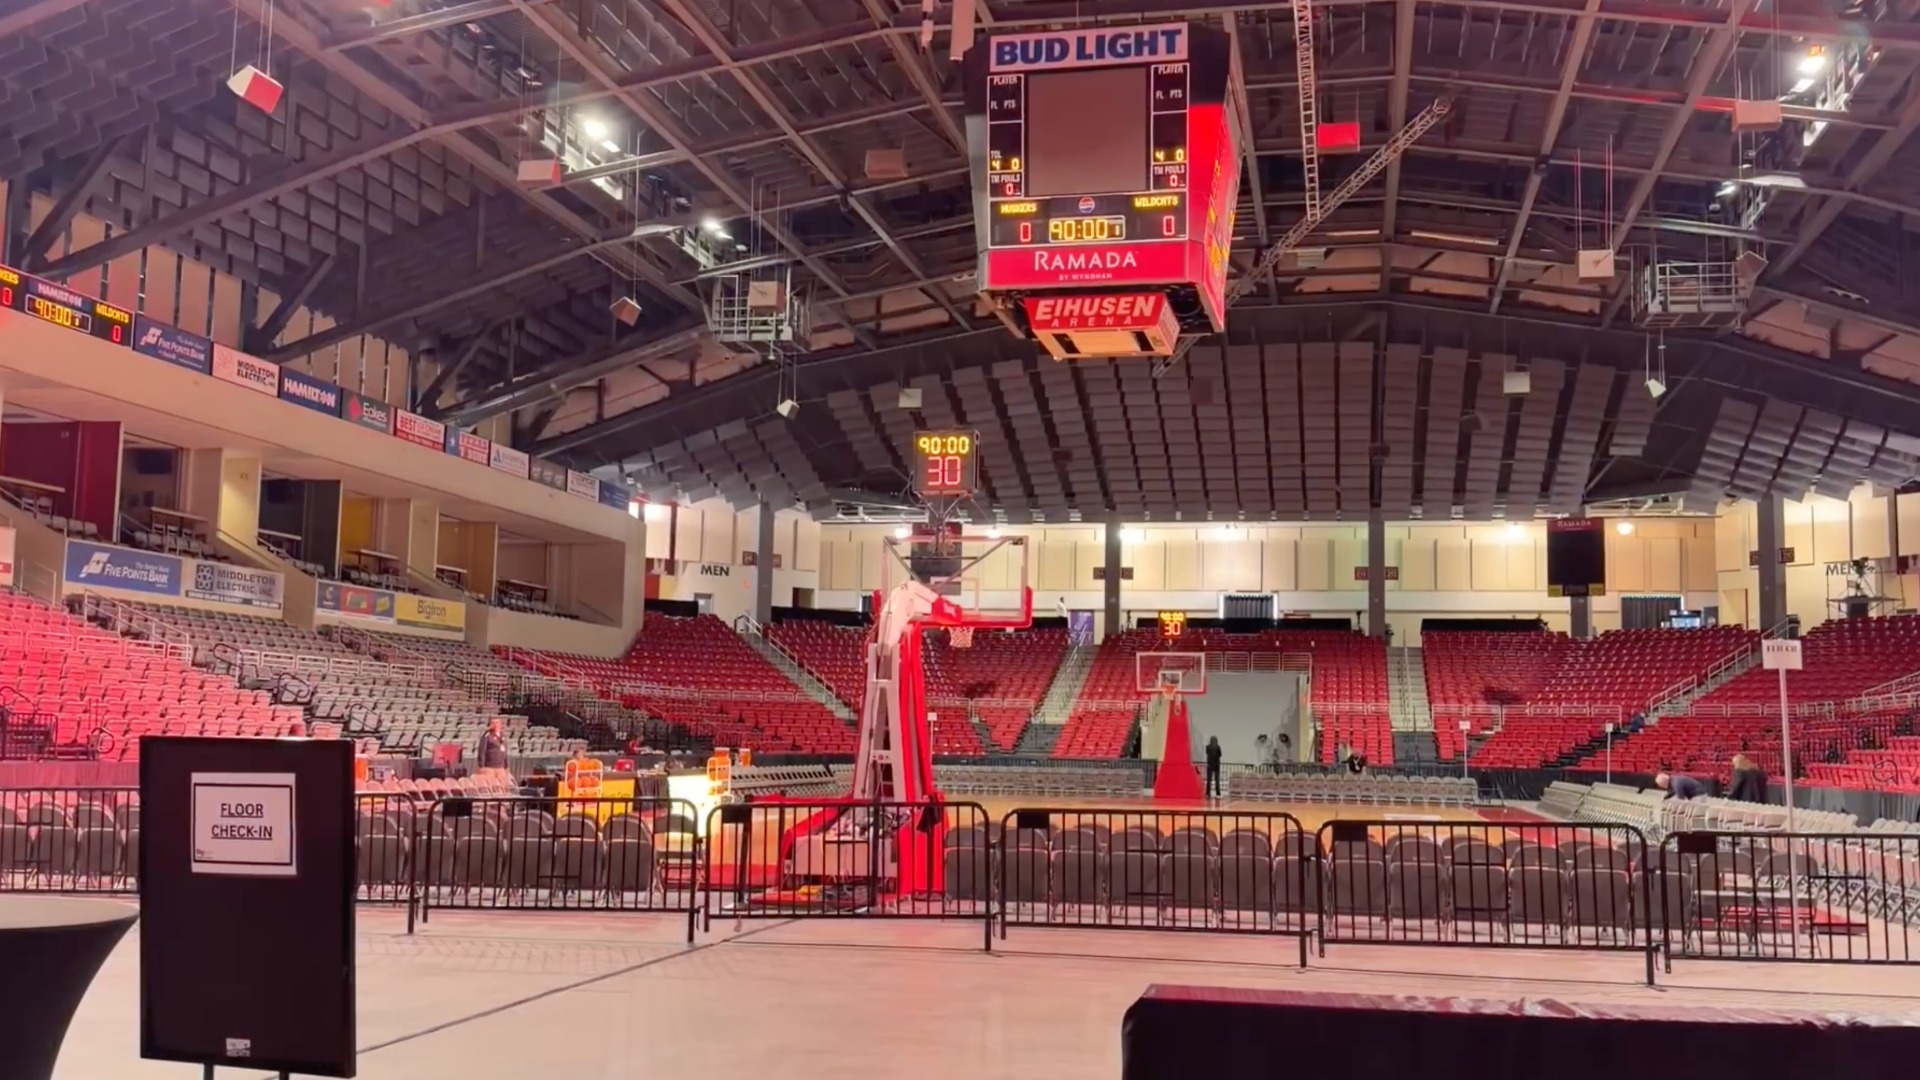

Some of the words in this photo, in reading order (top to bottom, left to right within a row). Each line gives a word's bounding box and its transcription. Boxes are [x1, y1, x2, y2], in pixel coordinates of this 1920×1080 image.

[995, 36, 1070, 66] BUD
[1076, 29, 1182, 60] LIGHT
[1158, 63, 1184, 75] PLAYER
[993, 76, 1018, 85] PLAYER
[1156, 90, 1164, 100] FL
[1170, 89, 1183, 99] PTS
[990, 100, 998, 110] FL
[1004, 99, 1016, 109] PTS
[991, 159, 1000, 170] 4
[1011, 158, 1020, 170] 0
[1155, 150, 1164, 162] 4
[1176, 149, 1184, 161] 0
[990, 174, 1000, 183] TM
[1000, 173, 1021, 183] FOULS
[1154, 166, 1163, 175] TM
[1164, 164, 1185, 175] FOULS
[1005, 182, 1014, 196] 0
[1169, 174, 1178, 187] 0
[1134, 195, 1179, 208] WILDCATS
[1020, 222, 1032, 243] 0
[1050, 219, 1108, 240] 90:00
[1163, 215, 1175, 236] 0
[1034, 250, 1138, 271] RAMADA
[2, 286, 12, 306] 0
[37, 283, 82, 307] HAMILTON
[35, 298, 71, 326] 90:00
[96, 303, 129, 323] WILDCATS
[1035, 296, 1156, 320] EIHUSEN
[1051, 315, 1132, 328] ARENA
[112, 324, 121, 342] 0
[237, 359, 276, 380] MIDDLETON
[284, 377, 337, 409] HAMILTON
[919, 436, 970, 455] 90:00
[927, 455, 961, 486] 30
[104, 563, 121, 578] FIVE
[121, 566, 149, 582] POINTS
[148, 570, 169, 584] BANK
[217, 568, 276, 586] MIDDLETON
[700, 564, 730, 577] MEN
[1164, 621, 1181, 636] 30
[220, 803, 264, 818] FLOOR
[211, 824, 273, 841] CHECK-IN
